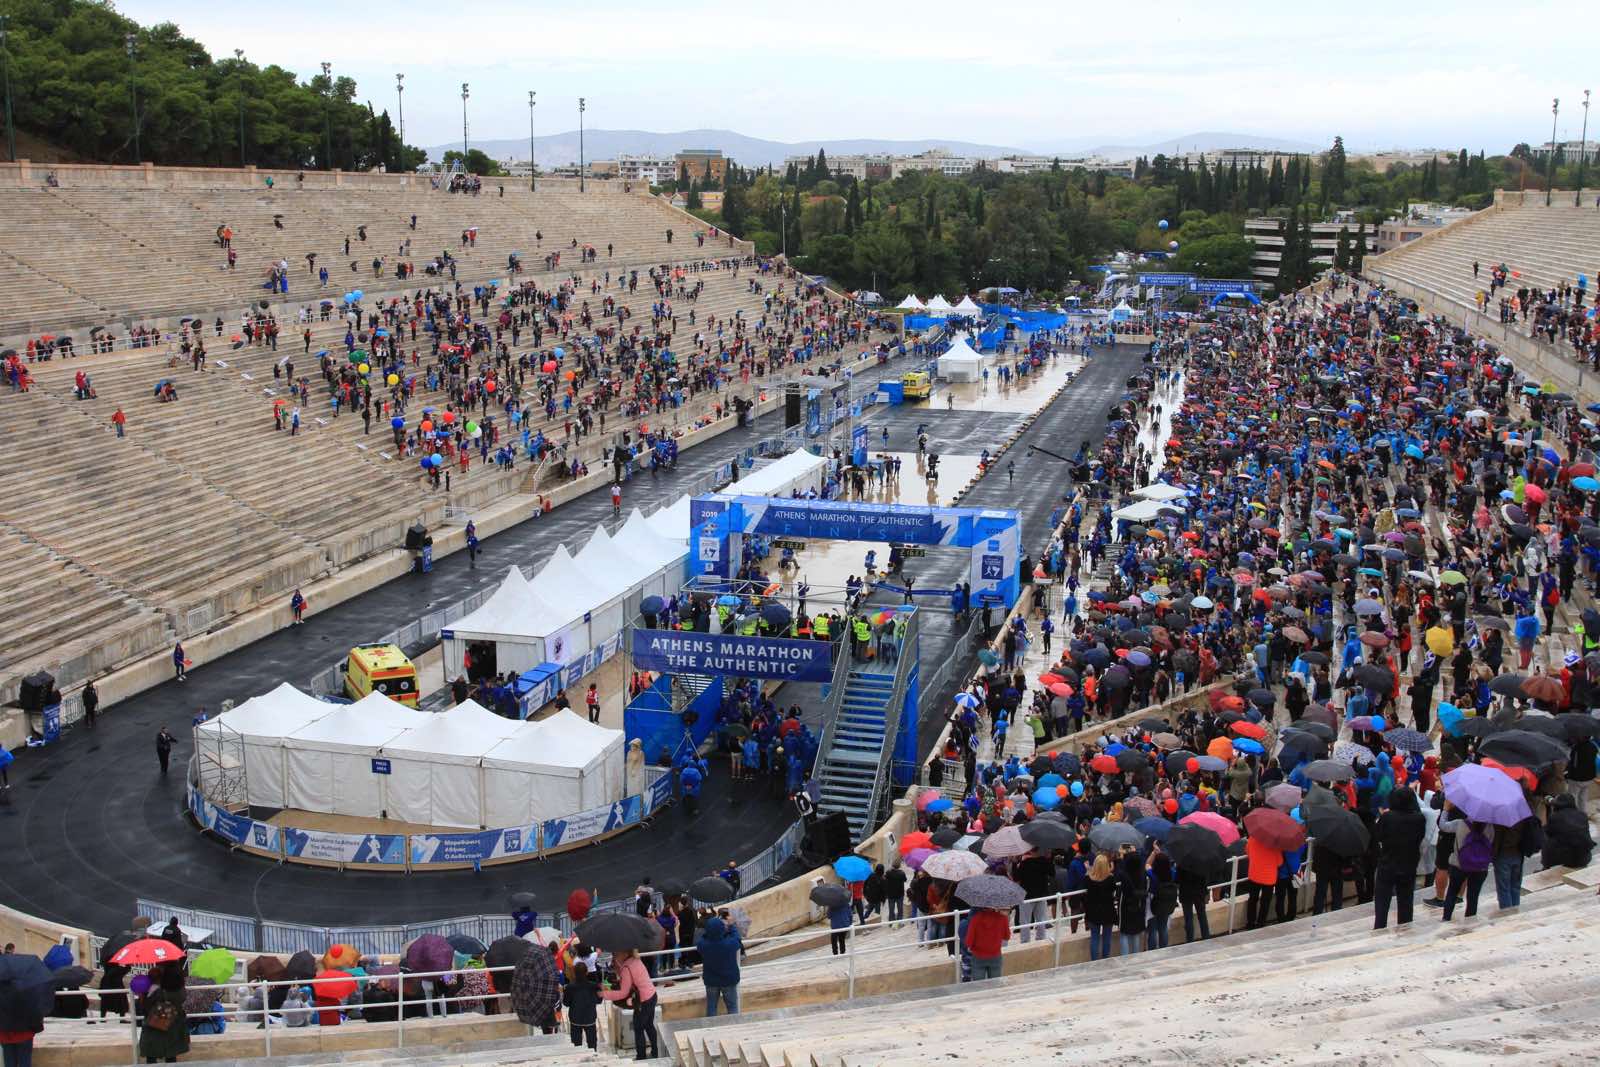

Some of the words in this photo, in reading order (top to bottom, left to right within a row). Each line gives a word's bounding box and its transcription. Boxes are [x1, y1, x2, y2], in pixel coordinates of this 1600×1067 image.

[774, 511, 806, 520] ATHENS
[860, 515, 875, 524] THE
[877, 516, 923, 526] AUTHENTIC
[784, 523, 915, 541] FINISH
[985, 527, 1004, 535] 2019
[650, 637, 713, 653] ATHENS
[720, 643, 813, 660] MARATHON
[667, 654, 697, 668] THE
[703, 658, 797, 674] AUTHENTIC
